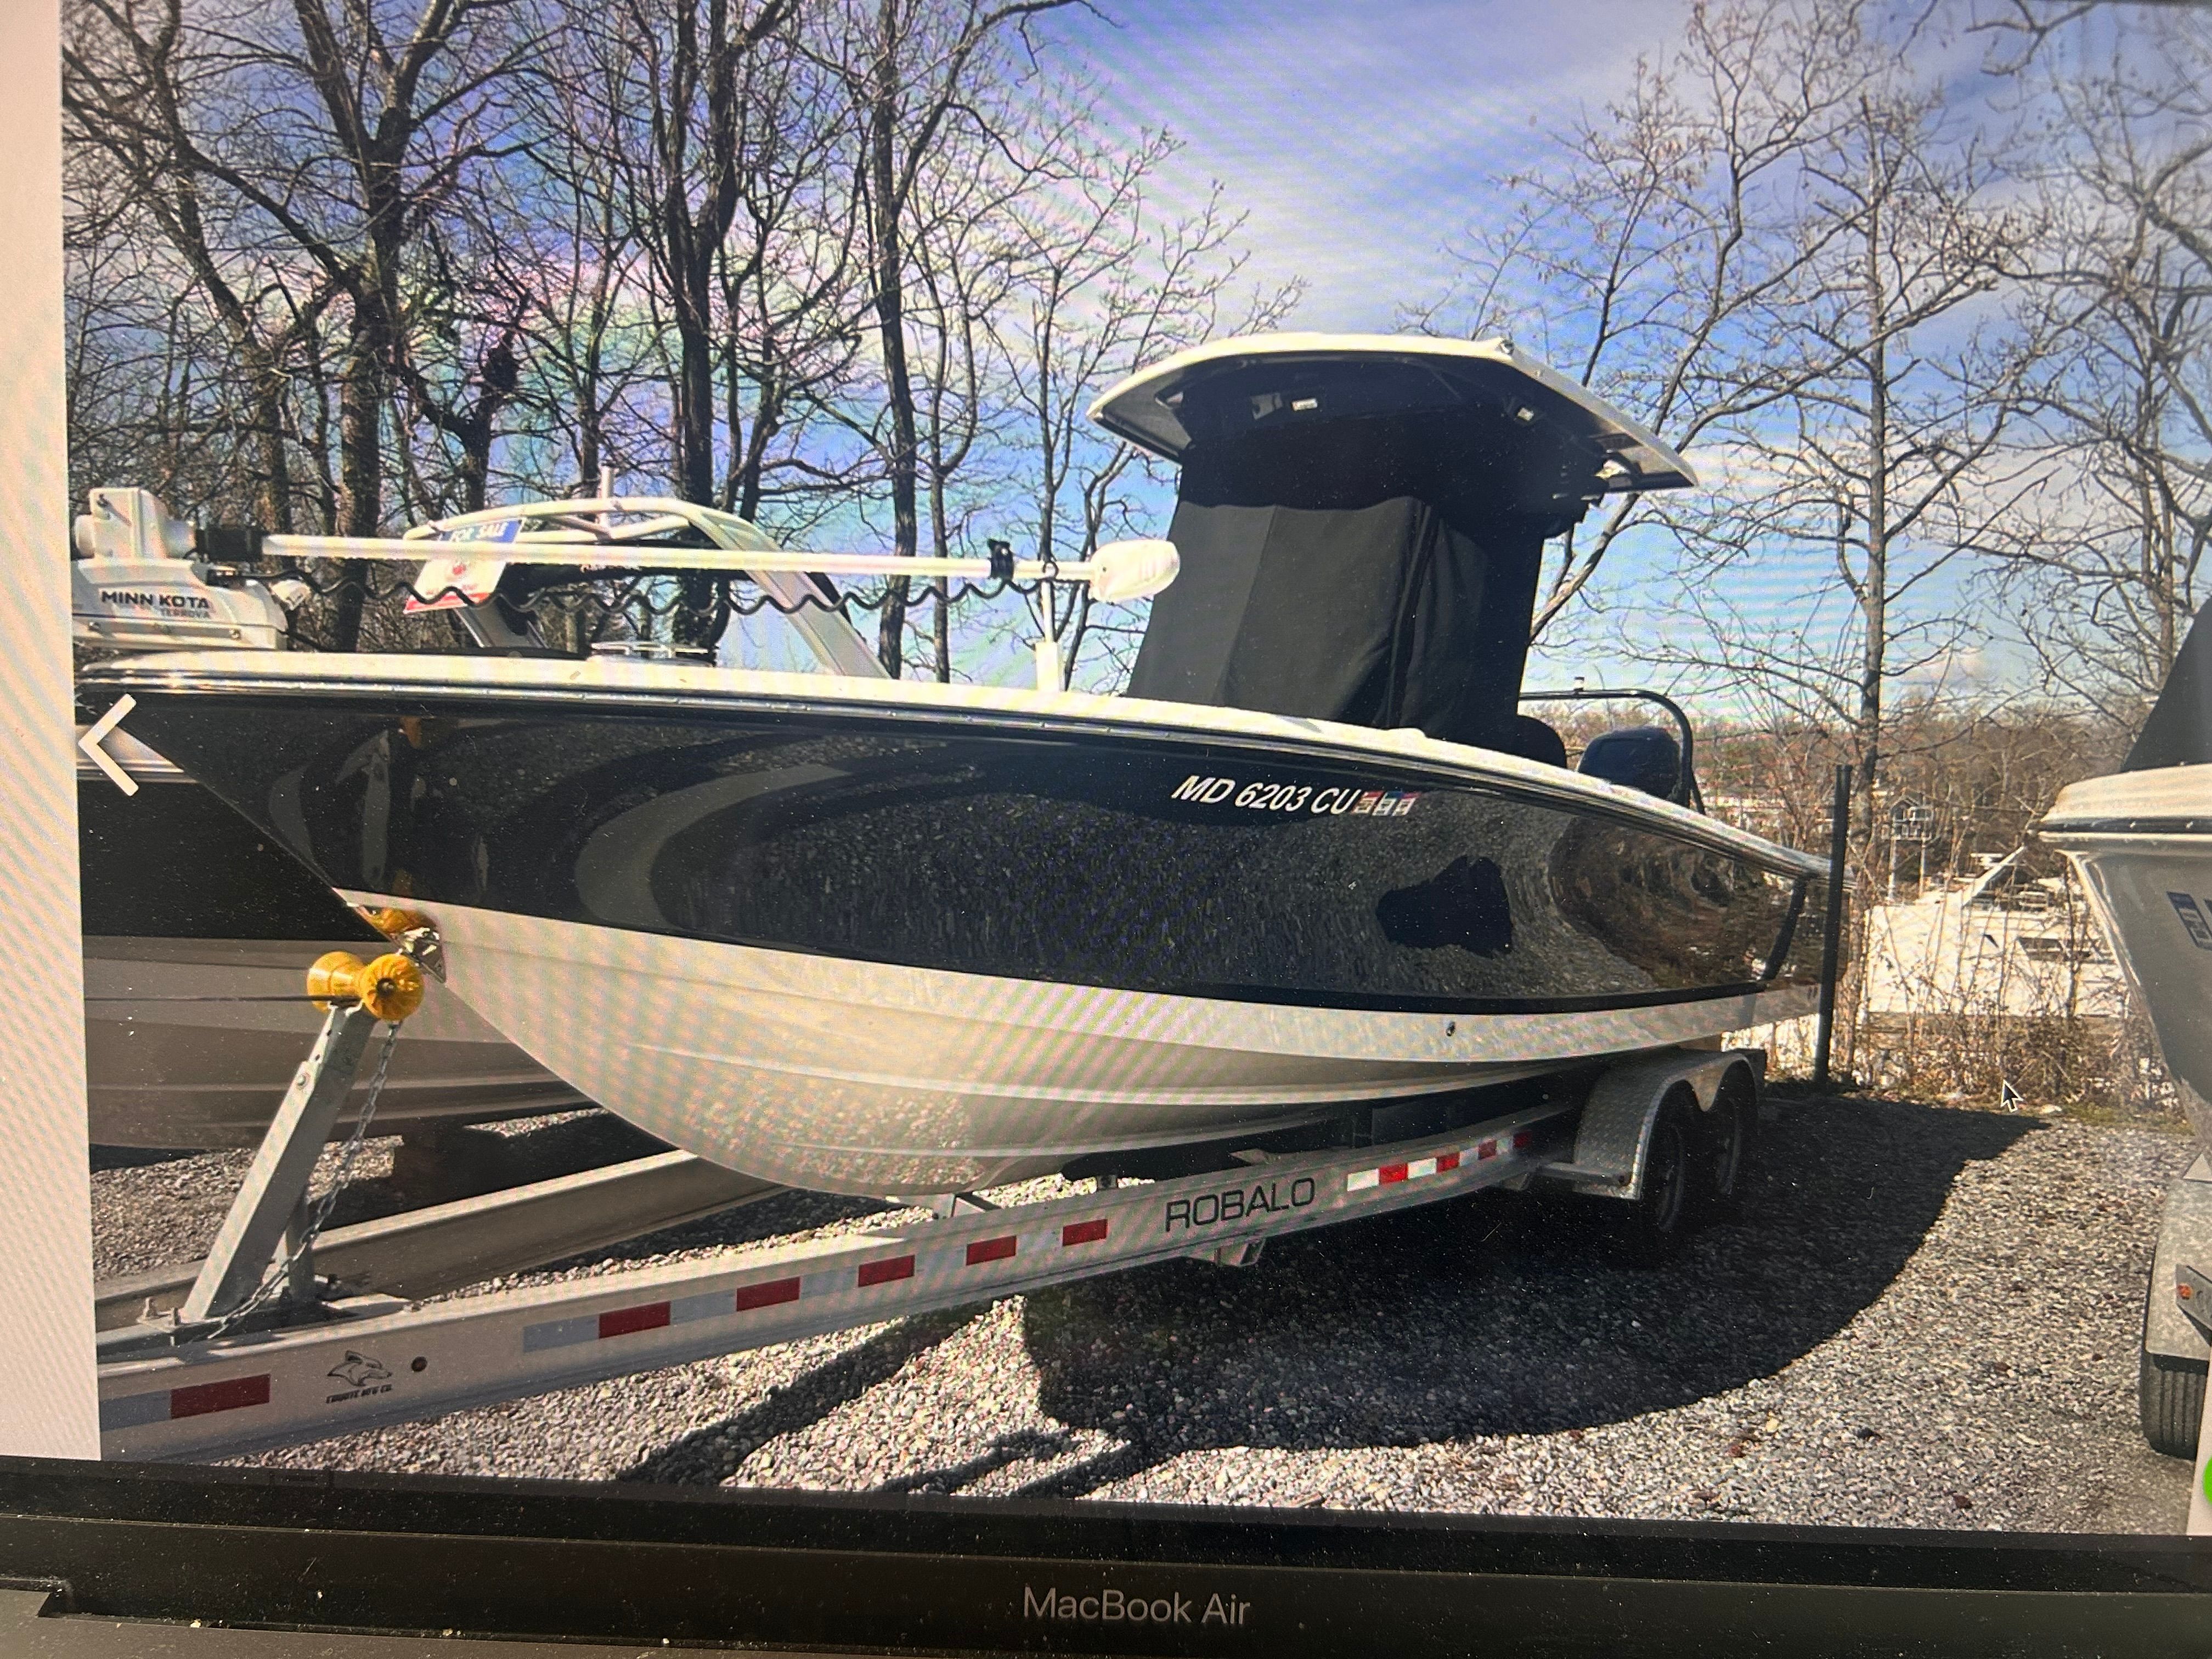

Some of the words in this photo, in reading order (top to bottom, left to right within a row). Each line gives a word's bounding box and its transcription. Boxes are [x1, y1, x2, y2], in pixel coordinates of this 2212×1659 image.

[101, 591, 153, 606] MINN
[159, 594, 210, 608] KOTA
[1171, 775, 1236, 804] MD
[1235, 782, 1311, 811] 6203
[1310, 788, 1362, 815] CU
[1165, 1177, 1316, 1233] ROBALO
[1024, 1584, 1193, 1623] MacBook
[1201, 1593, 1251, 1625] Air
